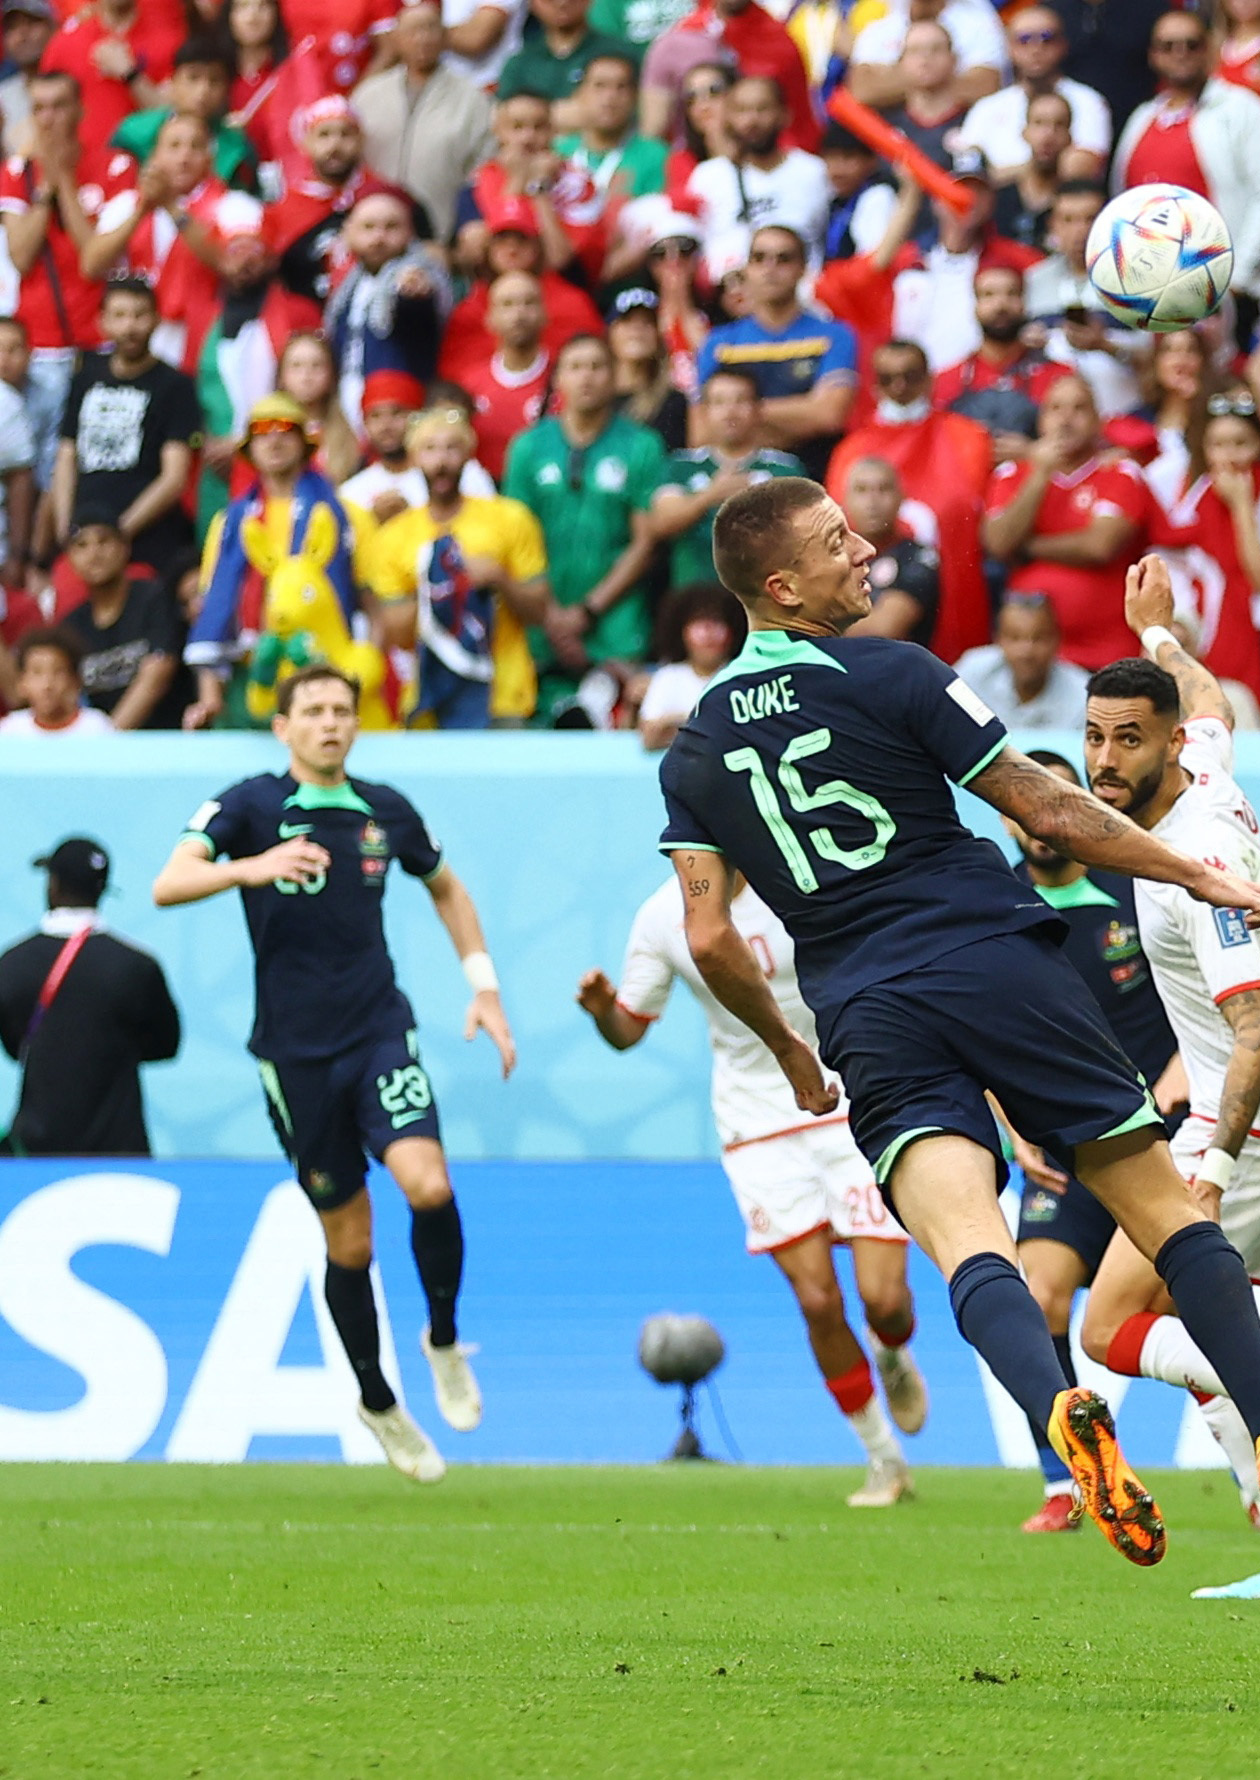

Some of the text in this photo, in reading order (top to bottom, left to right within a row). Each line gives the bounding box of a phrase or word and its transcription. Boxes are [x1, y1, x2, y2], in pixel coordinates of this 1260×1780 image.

[729, 673, 801, 724] DUKE
[723, 727, 897, 894] 15
[845, 1184, 888, 1227] 20
